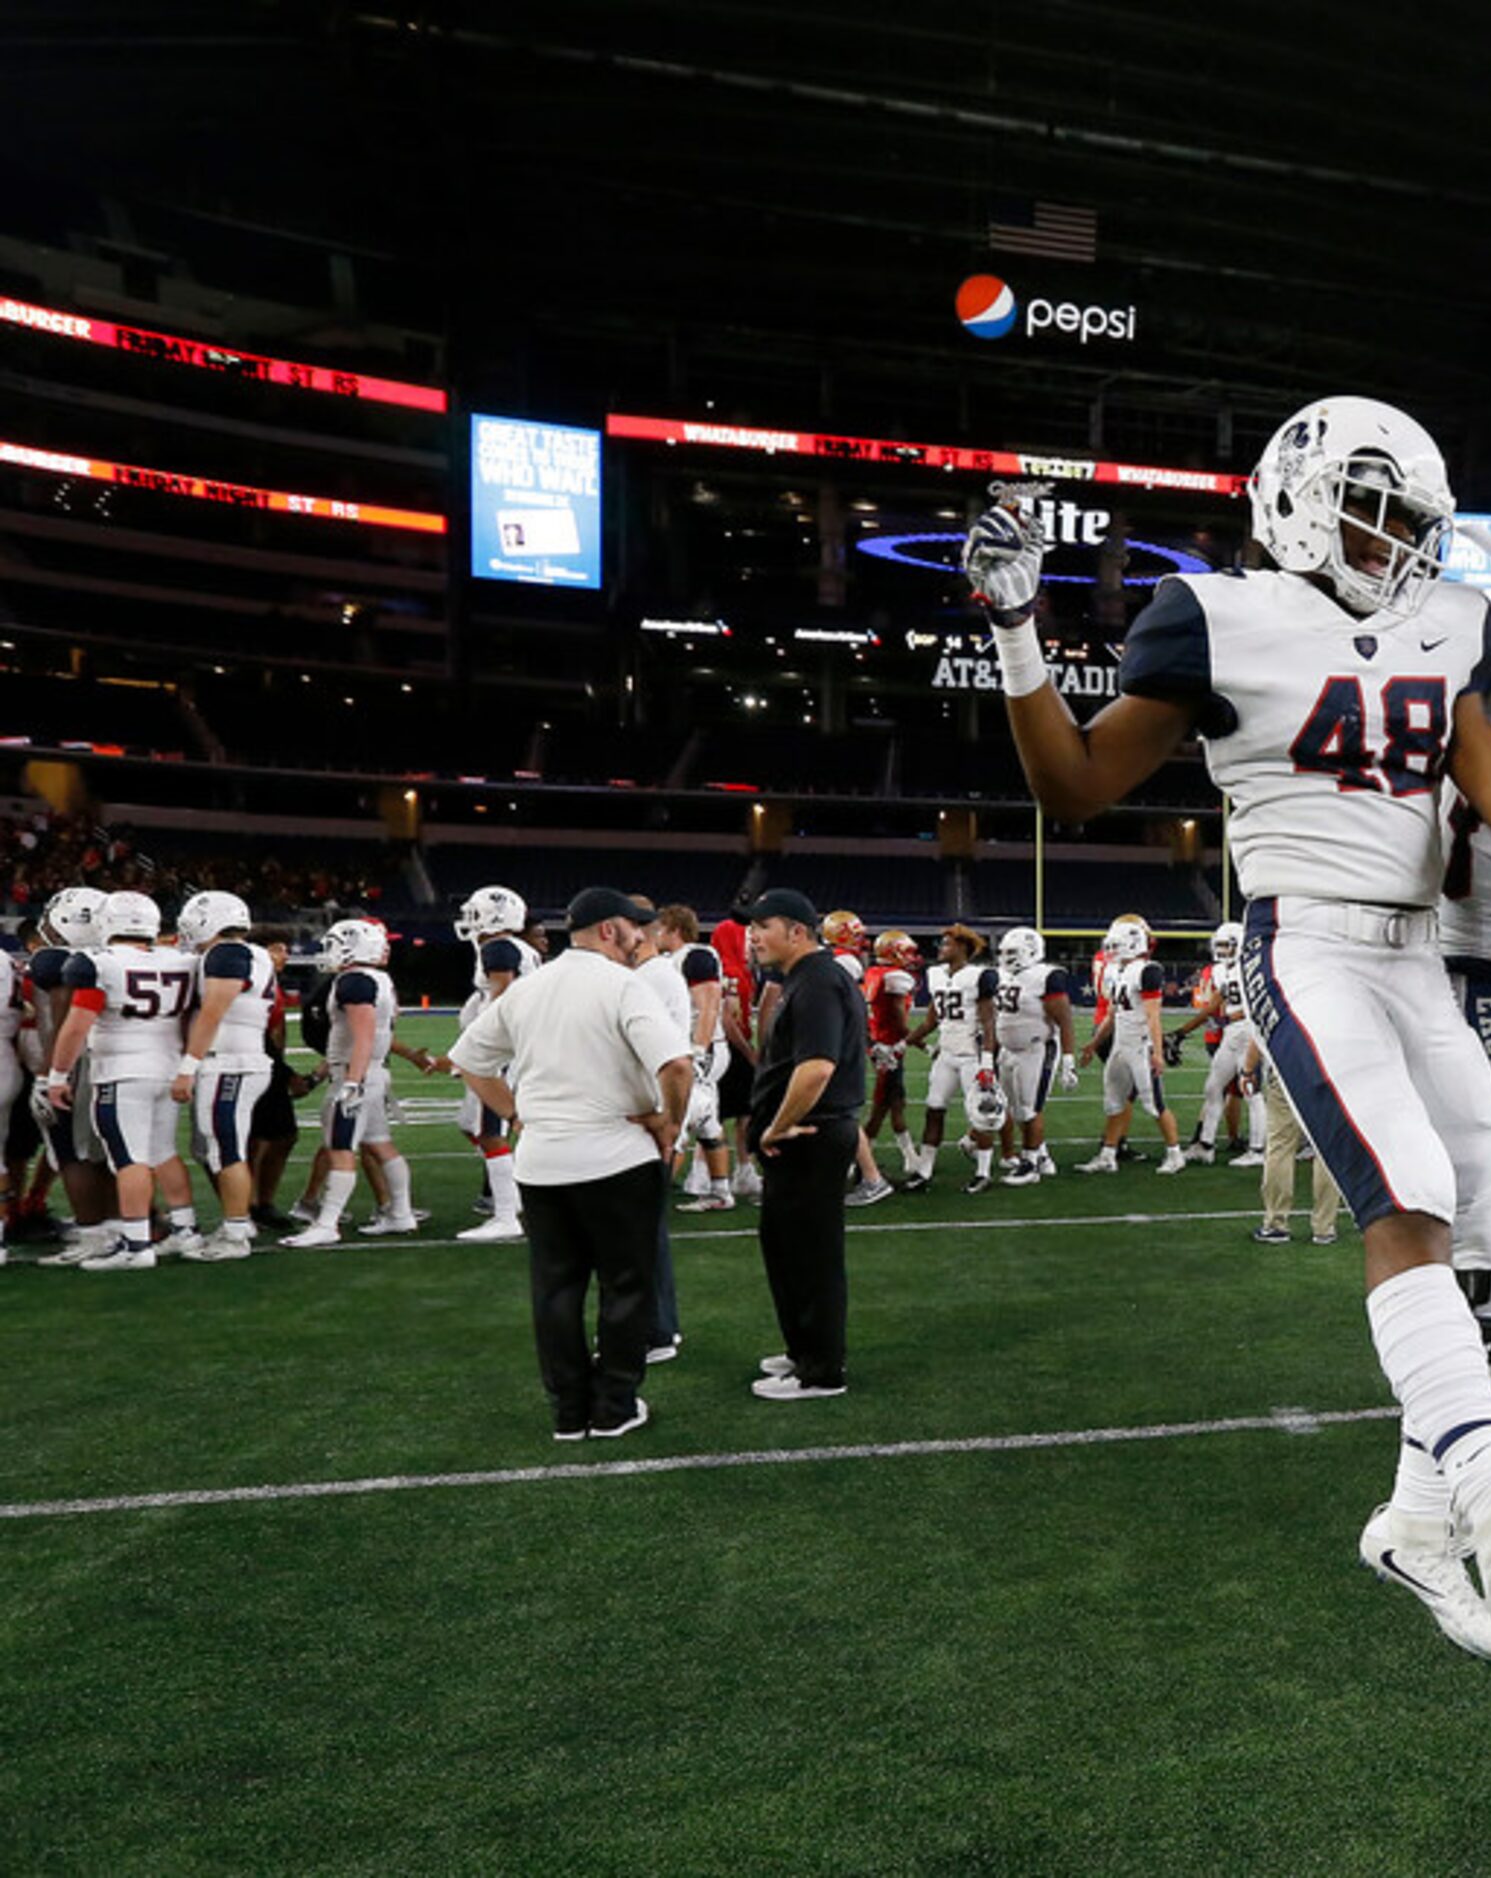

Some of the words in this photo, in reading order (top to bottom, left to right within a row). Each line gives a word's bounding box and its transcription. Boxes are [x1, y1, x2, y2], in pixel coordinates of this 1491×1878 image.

[1027, 298, 1136, 344] pepsi
[1046, 663, 1117, 697] TADI
[1289, 676, 1447, 798] 48
[121, 969, 191, 1020] 57
[933, 990, 965, 1022] 32
